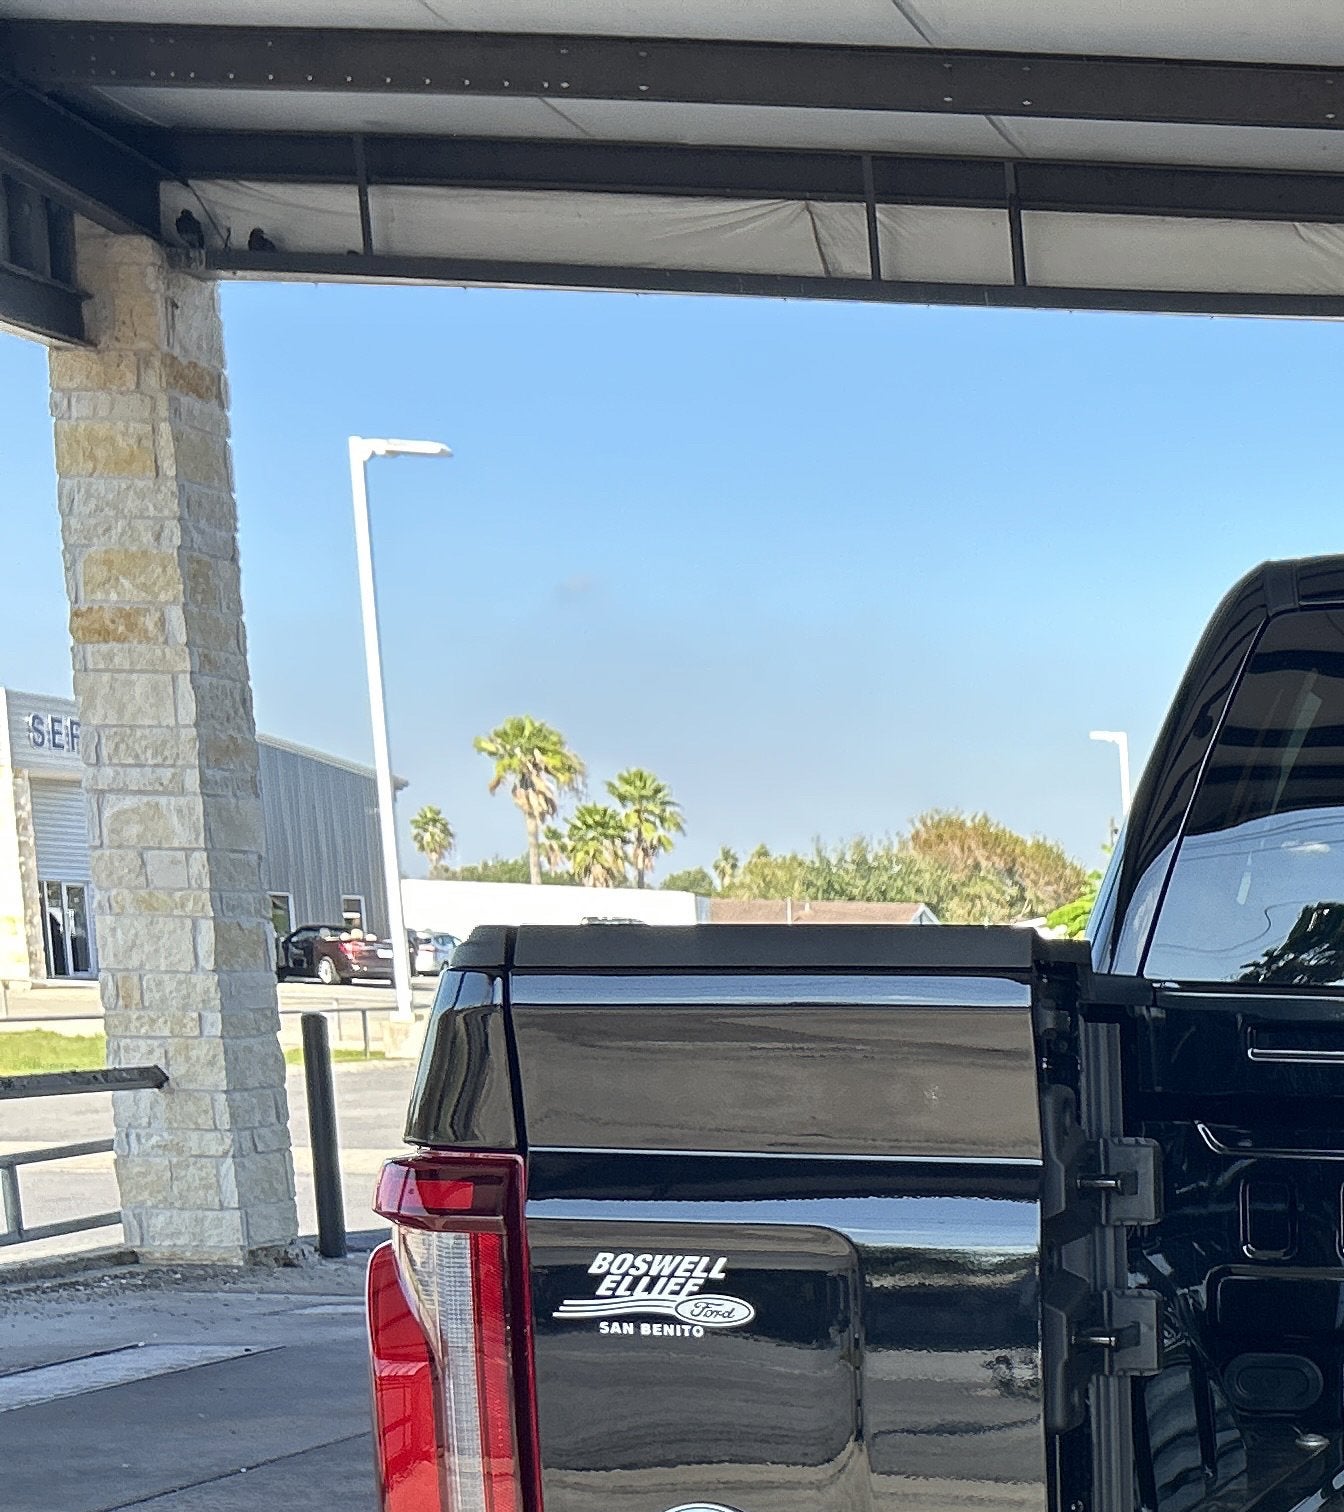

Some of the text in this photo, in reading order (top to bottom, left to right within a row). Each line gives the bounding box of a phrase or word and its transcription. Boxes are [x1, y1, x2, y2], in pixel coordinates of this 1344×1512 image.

[587, 1252, 728, 1279] BOSWELL
[595, 1274, 705, 1297] ELLIFF
[690, 1301, 735, 1319] Ford
[600, 1321, 704, 1338] SAN BENITO
